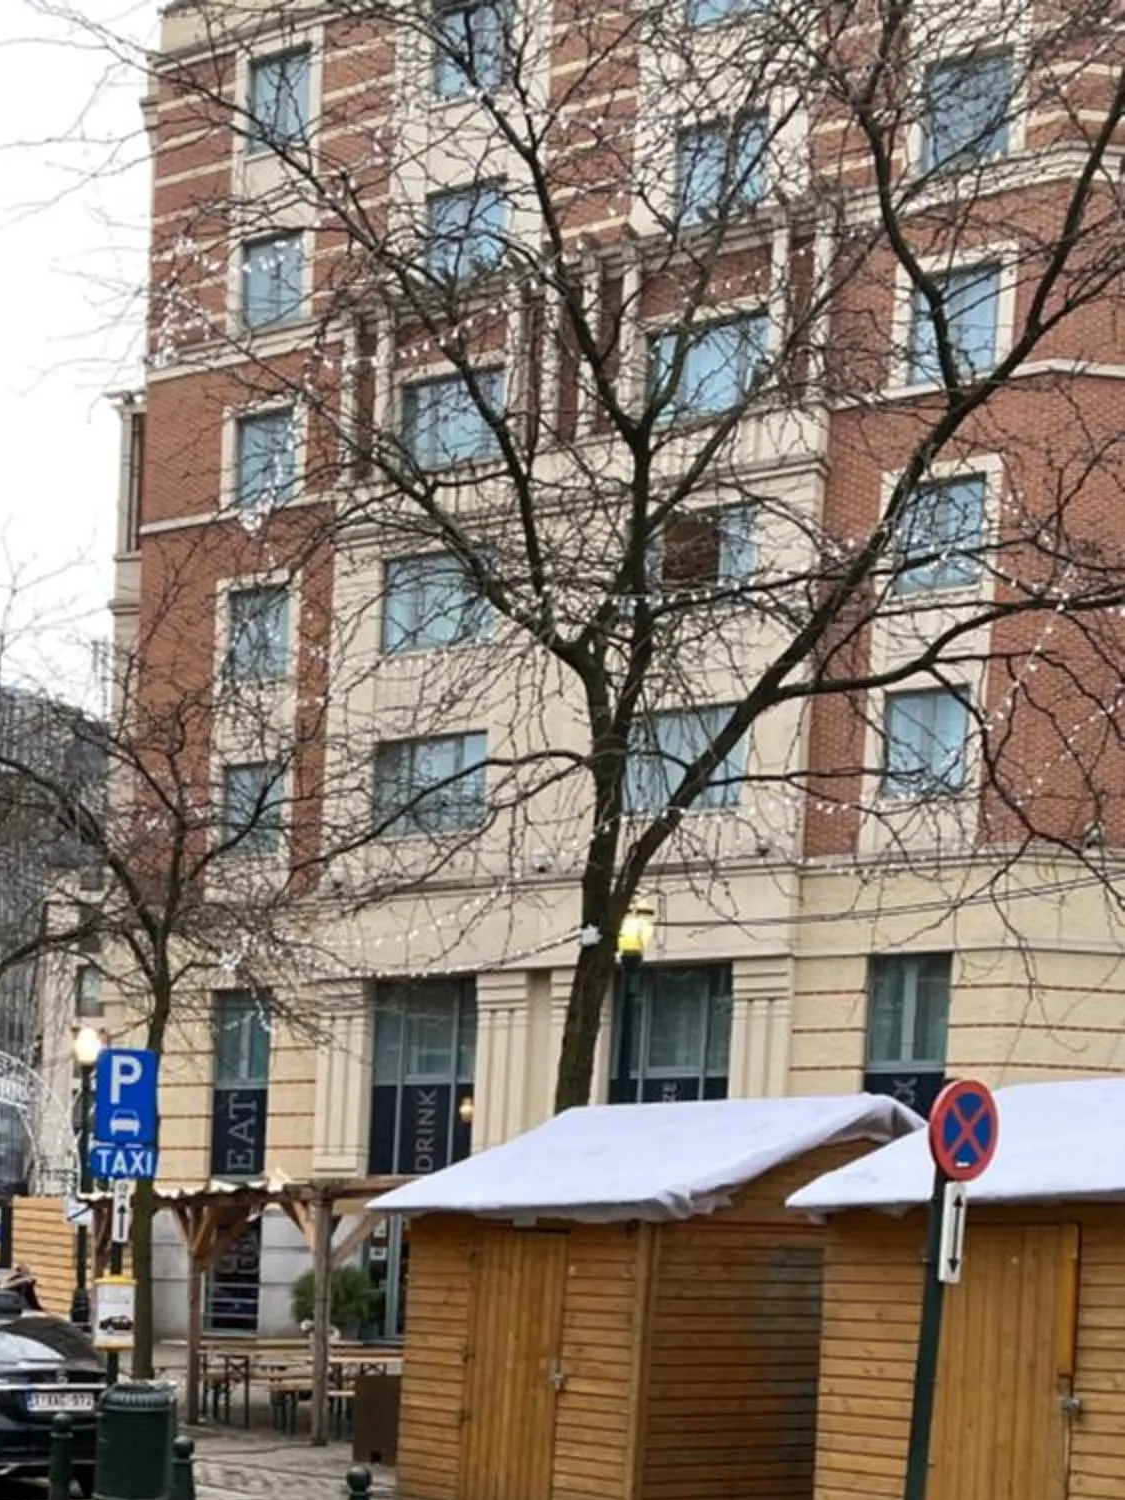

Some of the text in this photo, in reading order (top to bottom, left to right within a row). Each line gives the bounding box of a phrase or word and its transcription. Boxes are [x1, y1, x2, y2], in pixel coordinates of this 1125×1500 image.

[110, 1055, 143, 1105] P
[97, 1150, 154, 1175] TAXI
[227, 1092, 258, 1172] EAT
[415, 1088, 438, 1173] DRINK
